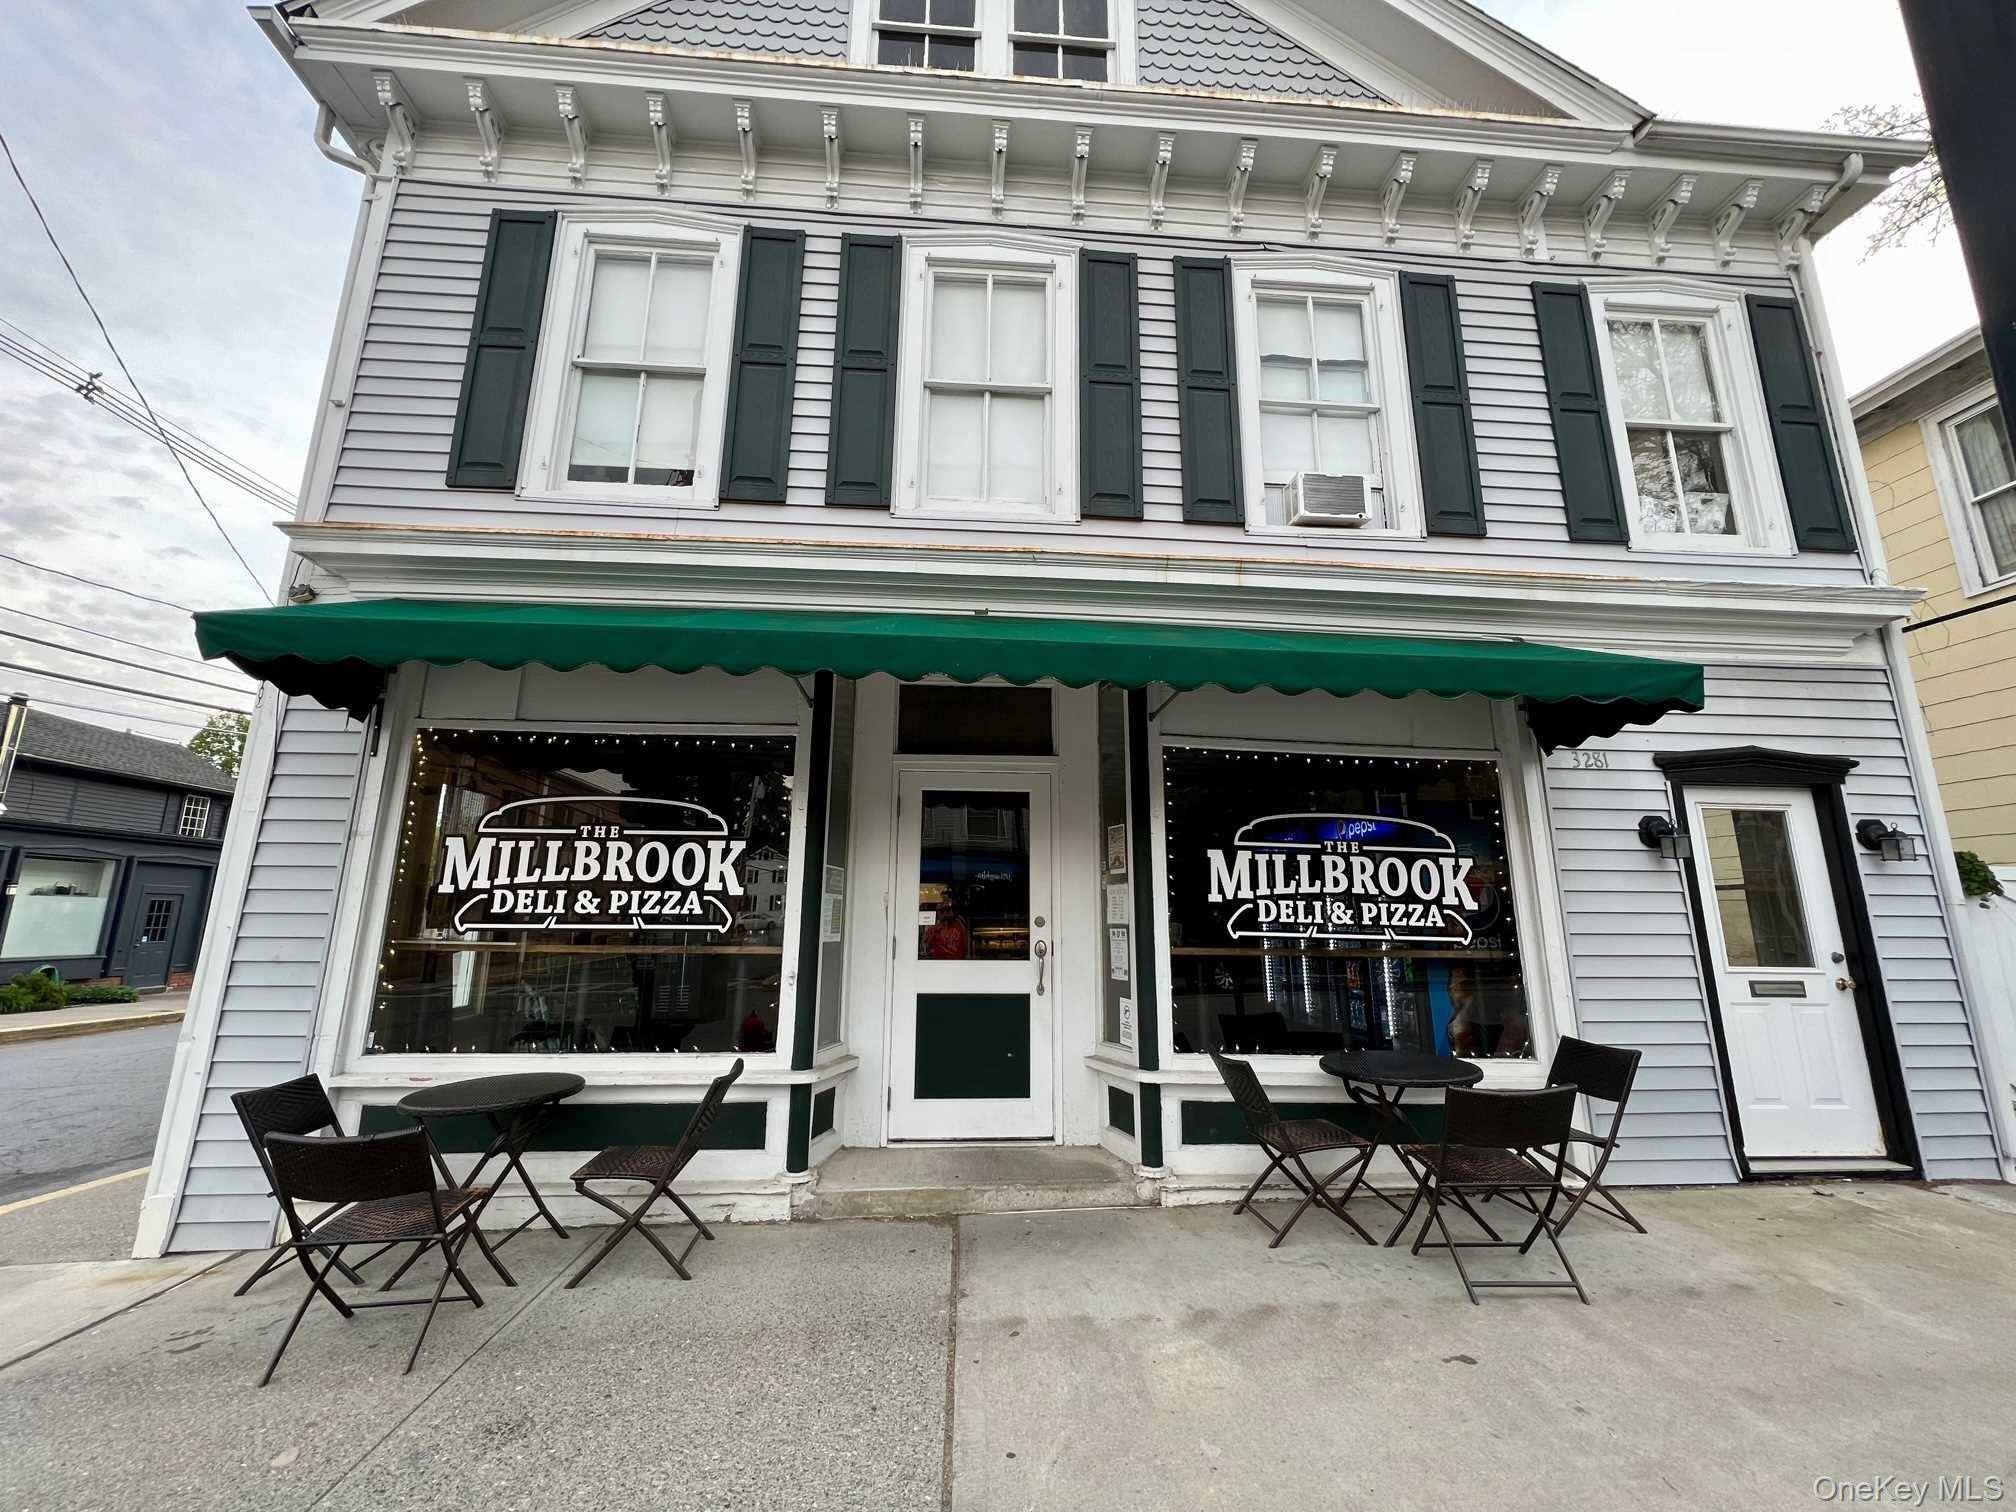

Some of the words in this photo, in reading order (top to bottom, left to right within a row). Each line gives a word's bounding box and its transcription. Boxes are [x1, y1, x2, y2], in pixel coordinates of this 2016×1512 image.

[1571, 751, 1609, 769] 3281
[580, 825, 620, 838] THE
[1348, 820, 1377, 840] pepsi
[1324, 840, 1360, 854] THE
[437, 836, 747, 896] MILLBROOK
[1207, 849, 1479, 911] MILLBROOK
[490, 889, 567, 914] DELI
[573, 889, 601, 914] &
[608, 890, 703, 915] PIZZA
[1256, 899, 1324, 924] DELI
[1330, 901, 1355, 925] &
[1360, 902, 1446, 927] PIZZA
